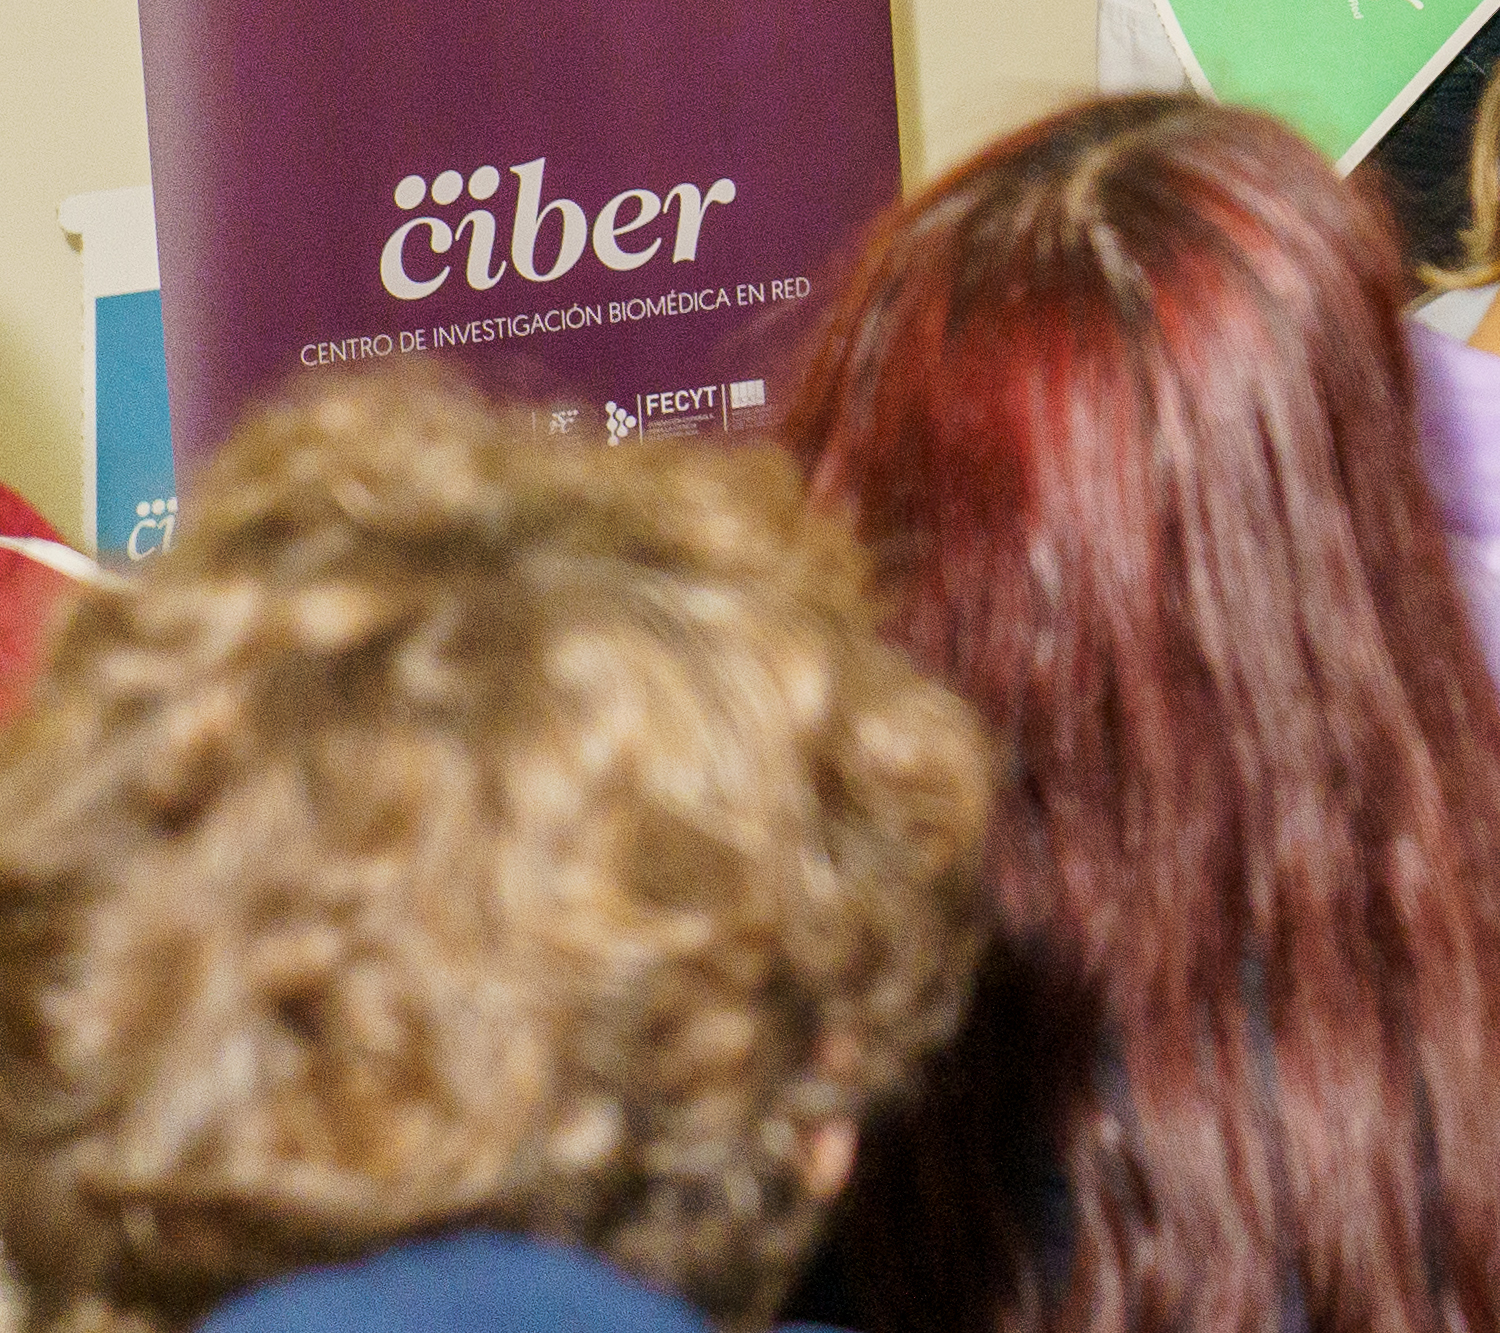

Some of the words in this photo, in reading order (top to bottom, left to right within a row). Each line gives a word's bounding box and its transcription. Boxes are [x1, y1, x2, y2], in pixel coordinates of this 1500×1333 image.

[380, 157, 736, 299] ciber
[300, 334, 393, 367] CENTRO
[400, 331, 427, 353] DE
[433, 303, 602, 347] INVESTIGACIÓN
[608, 288, 731, 324] BIOMÉDICA
[737, 282, 766, 306] EN
[772, 277, 811, 301] RED
[646, 386, 717, 416] FECYT
